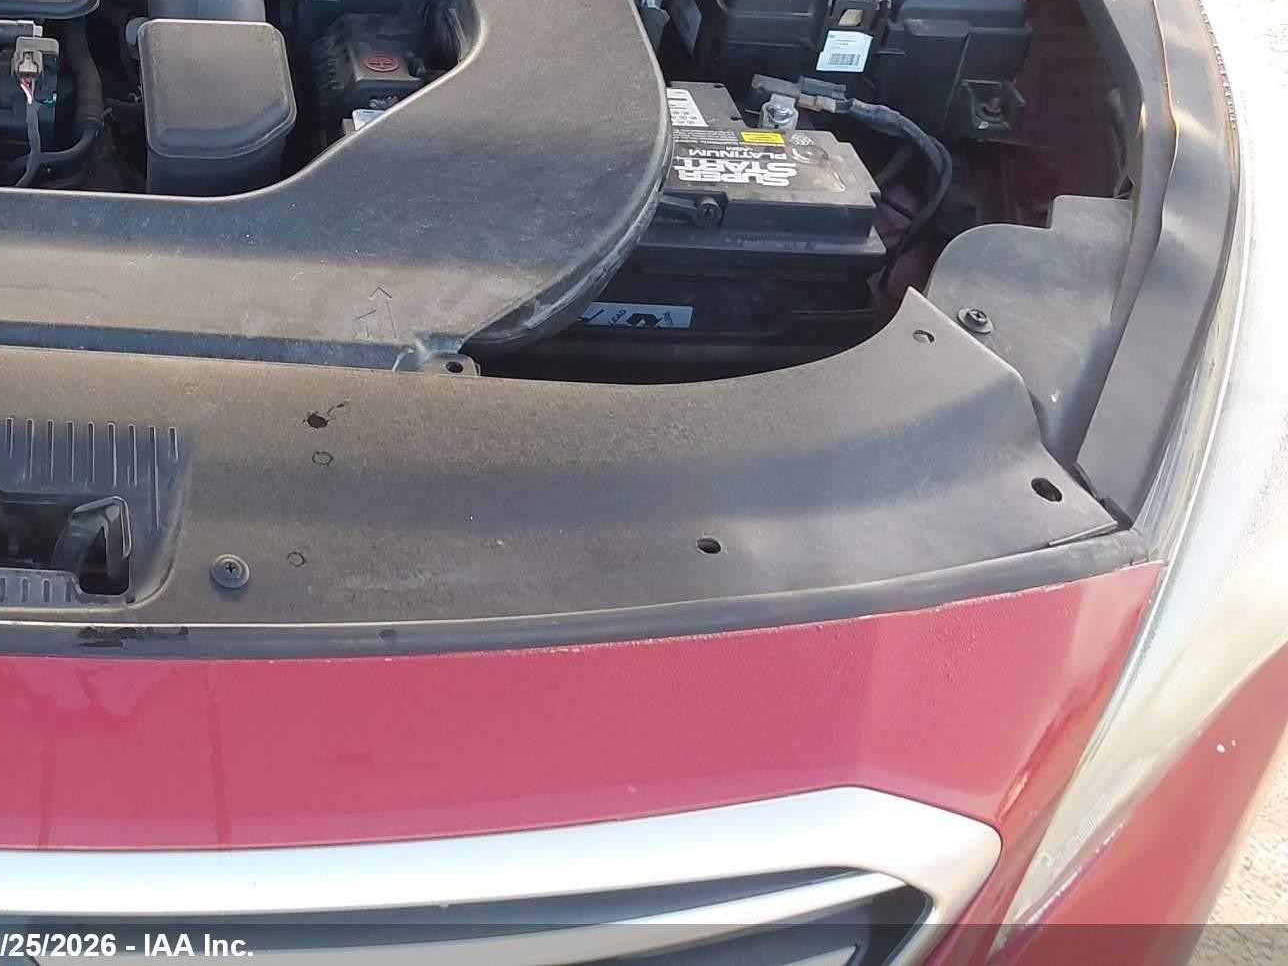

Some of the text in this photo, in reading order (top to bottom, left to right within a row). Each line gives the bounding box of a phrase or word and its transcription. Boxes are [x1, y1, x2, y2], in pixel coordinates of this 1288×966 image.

[688, 148, 788, 160] PLATINUM
[673, 159, 798, 177] START
[678, 169, 790, 187] SUPER
